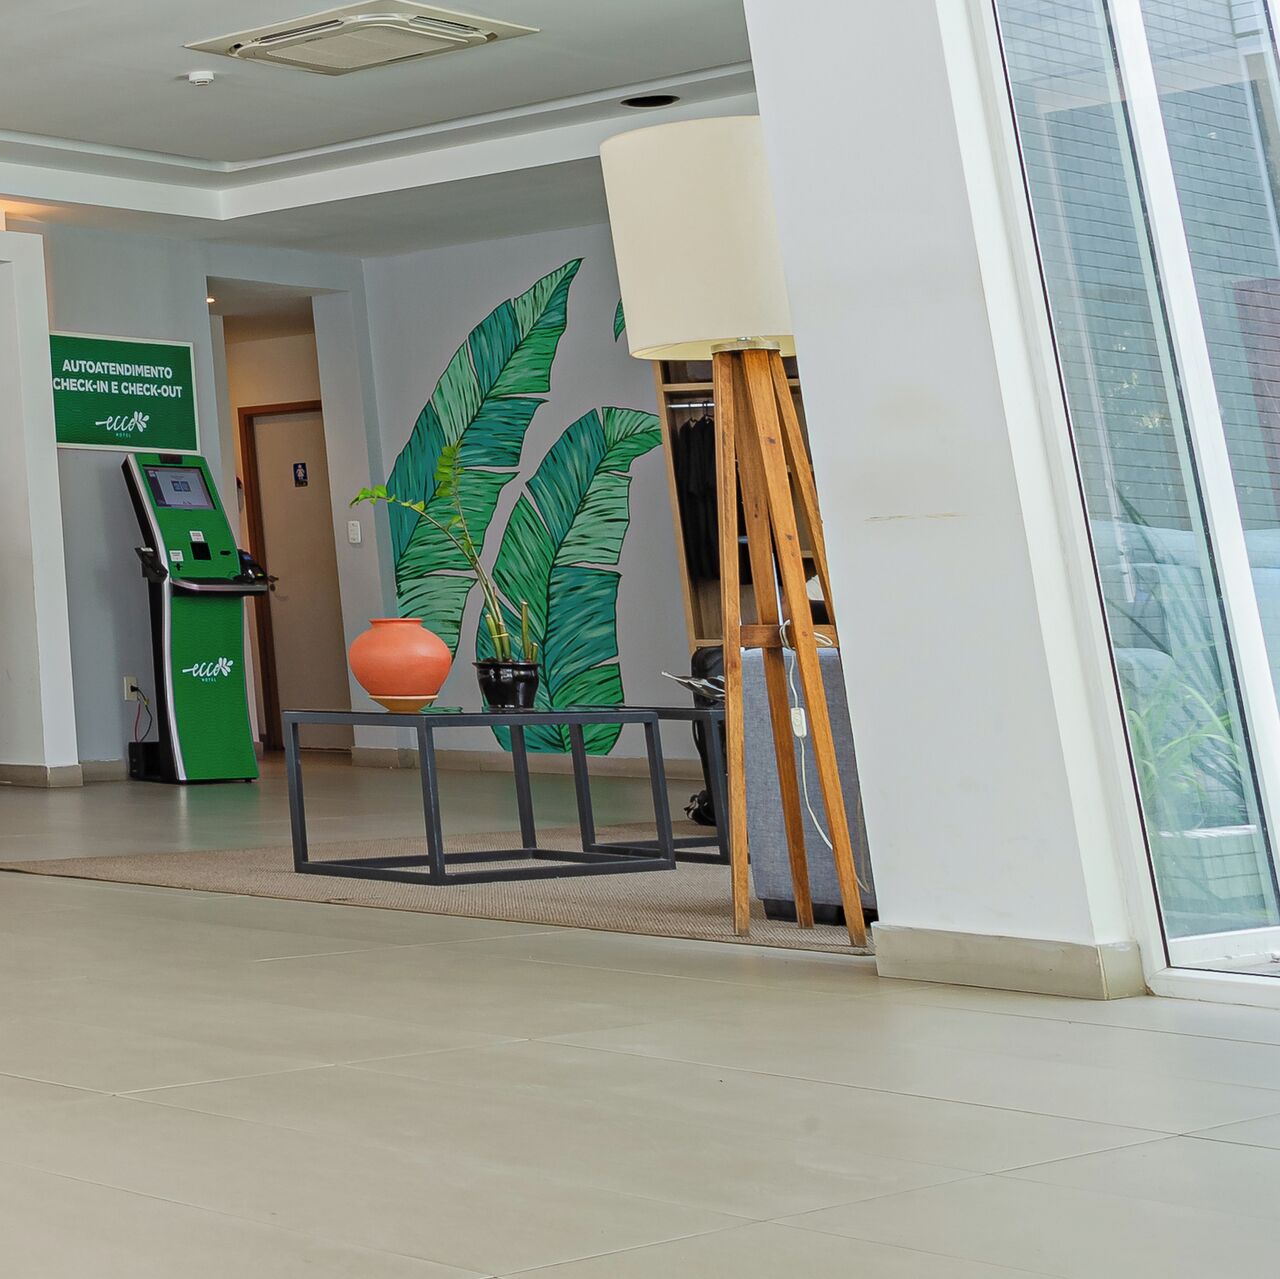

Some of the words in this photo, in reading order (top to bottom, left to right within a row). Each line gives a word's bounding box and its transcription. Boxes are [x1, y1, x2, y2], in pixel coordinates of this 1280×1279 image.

[62, 359, 173, 379] AUTOATENDIMENTO
[52, 377, 109, 393] CHECK-IN
[111, 381, 119, 393] E
[120, 382, 183, 398] CHECK-OUT
